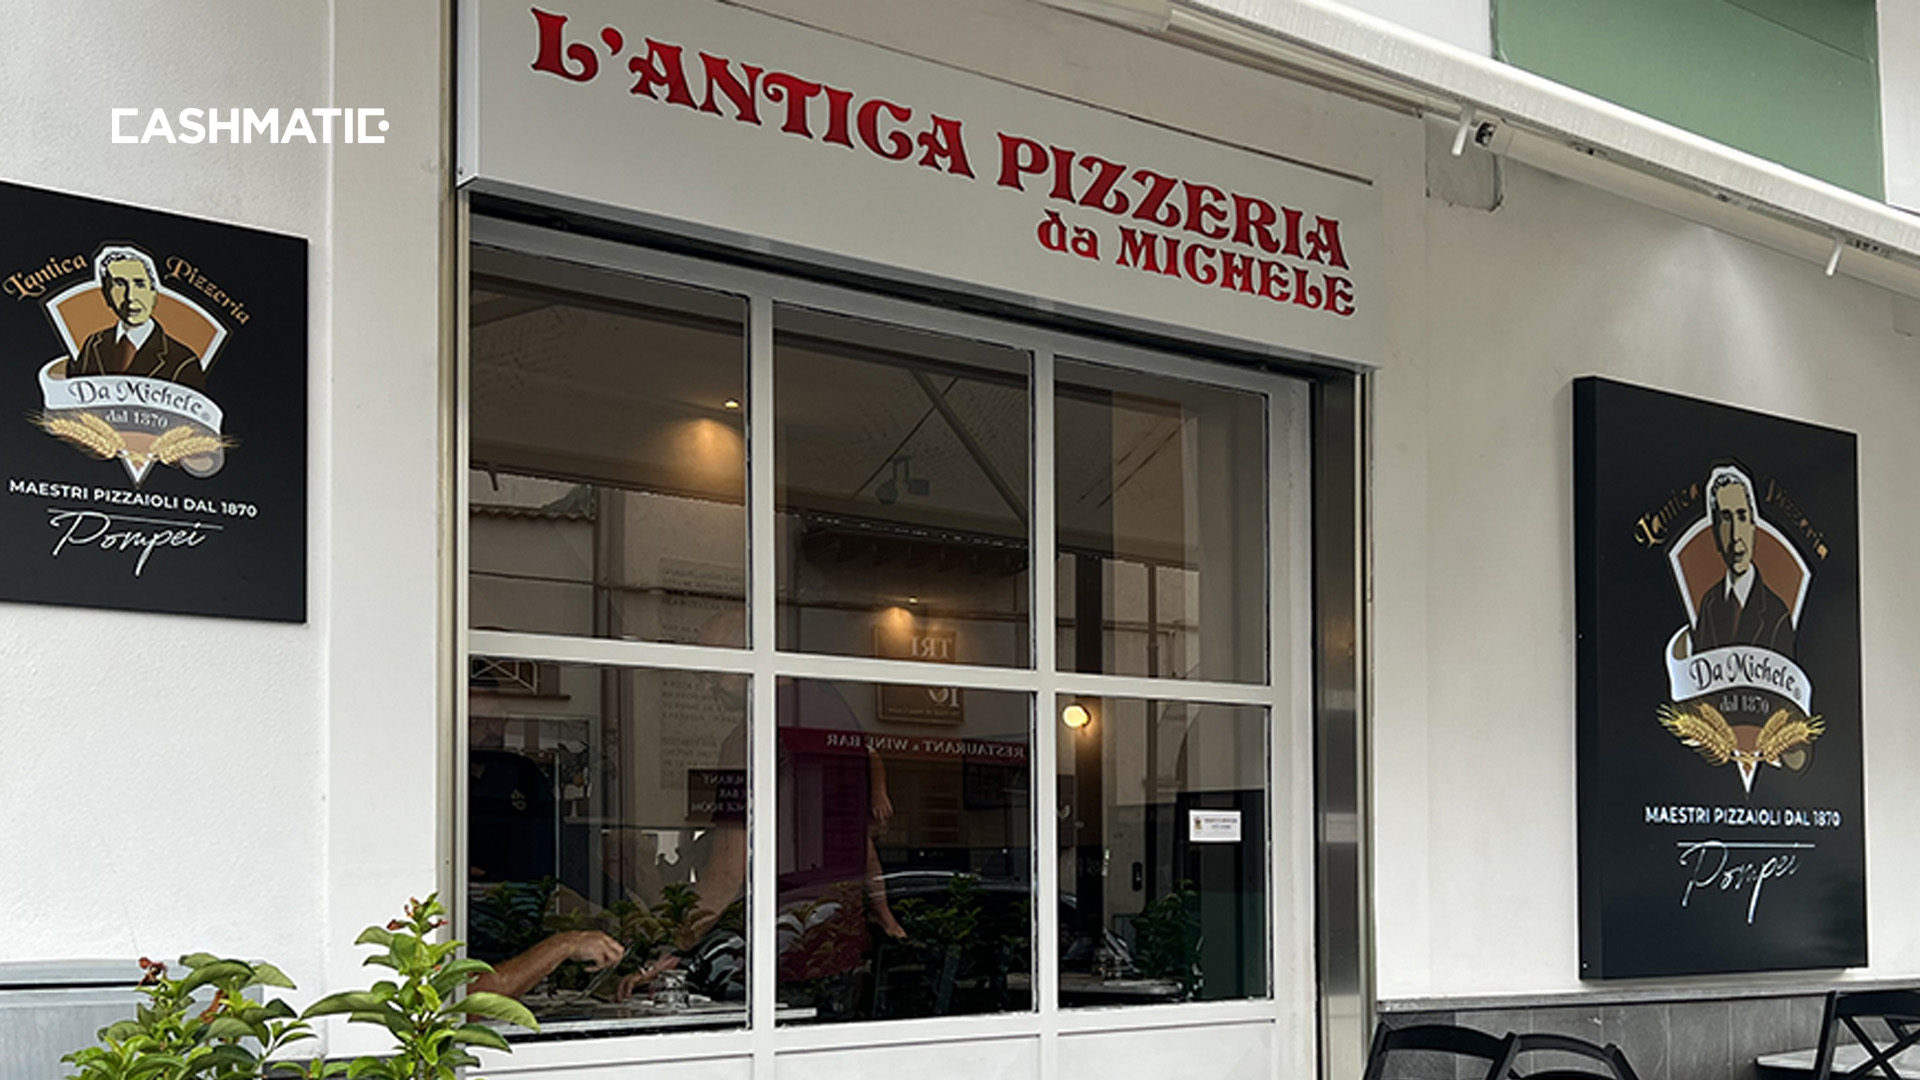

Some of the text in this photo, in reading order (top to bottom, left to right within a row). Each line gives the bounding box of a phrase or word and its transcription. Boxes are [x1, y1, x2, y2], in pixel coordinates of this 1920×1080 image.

[531, 8, 1349, 270] L'ANTICA PIZZERIA
[1037, 209, 1356, 317] da MICHELE
[2, 254, 251, 325] L'antica Pizzeria
[68, 380, 202, 415] Da Michele
[105, 409, 169, 428] dal 1870
[9, 479, 258, 519] MAESTRI PIZZAIOLI DAL 1870
[50, 511, 206, 576] Pompei
[1689, 652, 1796, 692] Da Michele
[1645, 806, 1841, 827] MAESTRI PIZZAIOLI DAL 1870
